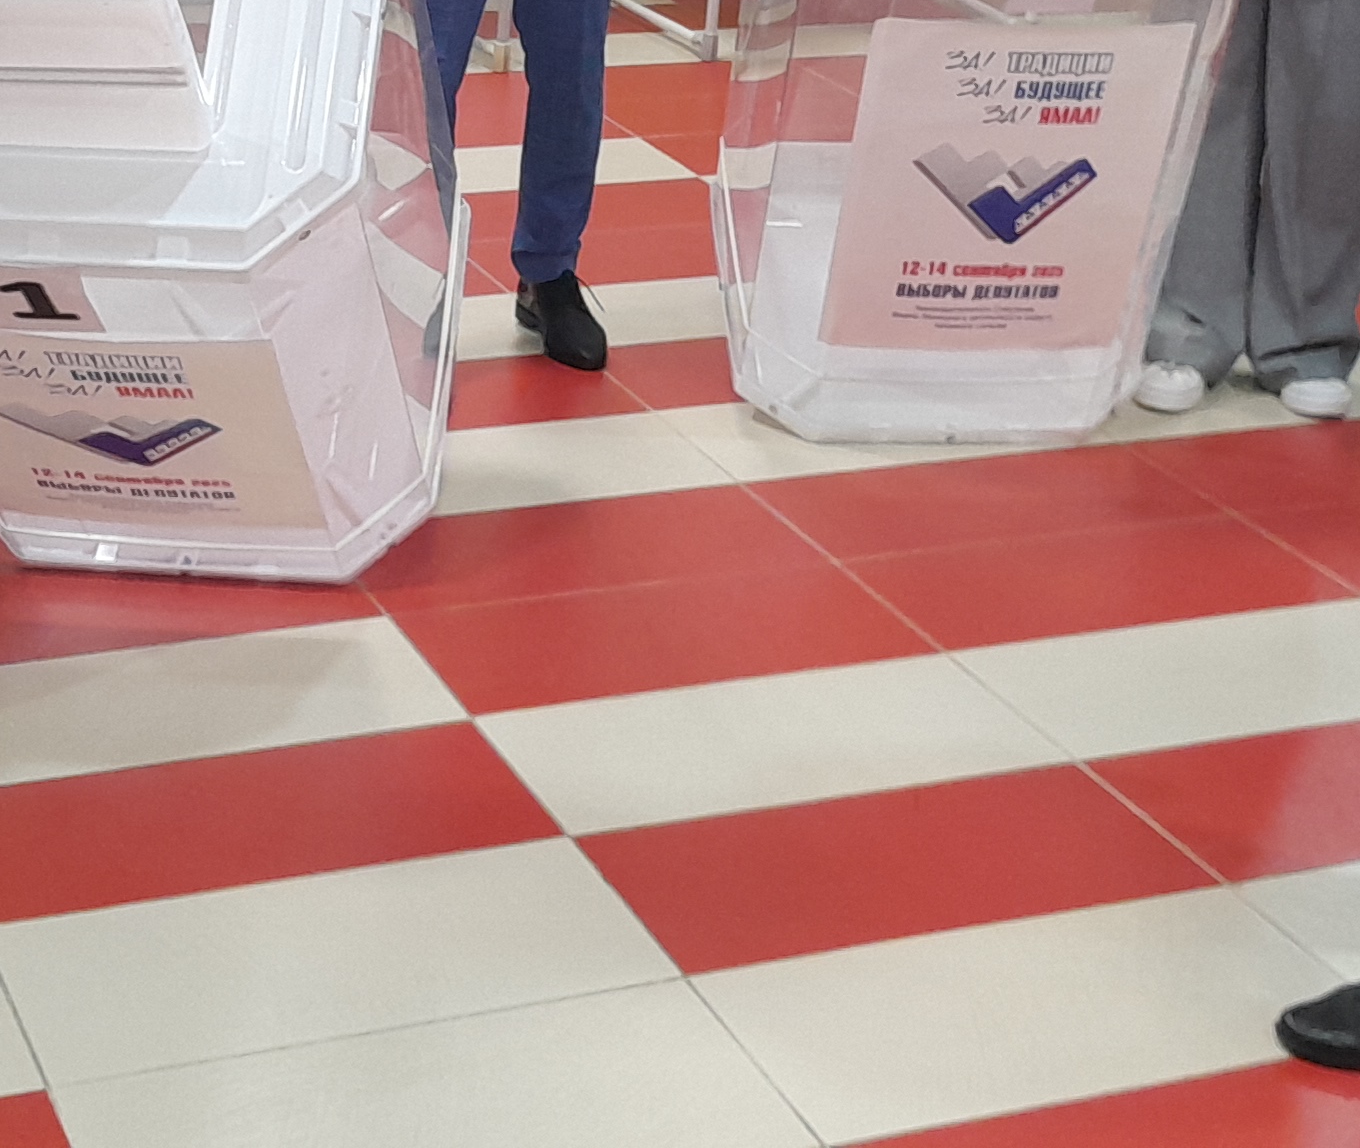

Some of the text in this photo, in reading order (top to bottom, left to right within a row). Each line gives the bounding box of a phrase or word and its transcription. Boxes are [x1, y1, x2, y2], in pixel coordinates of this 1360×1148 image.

[1007, 51, 1114, 76] ТРАДИЦИИ
[1014, 80, 1107, 102] БУДУЩЕЕ
[1038, 106, 1103, 126] ЯМАЛ!
[901, 261, 947, 276] 12-14
[895, 283, 968, 298] ВЫБОРЫ
